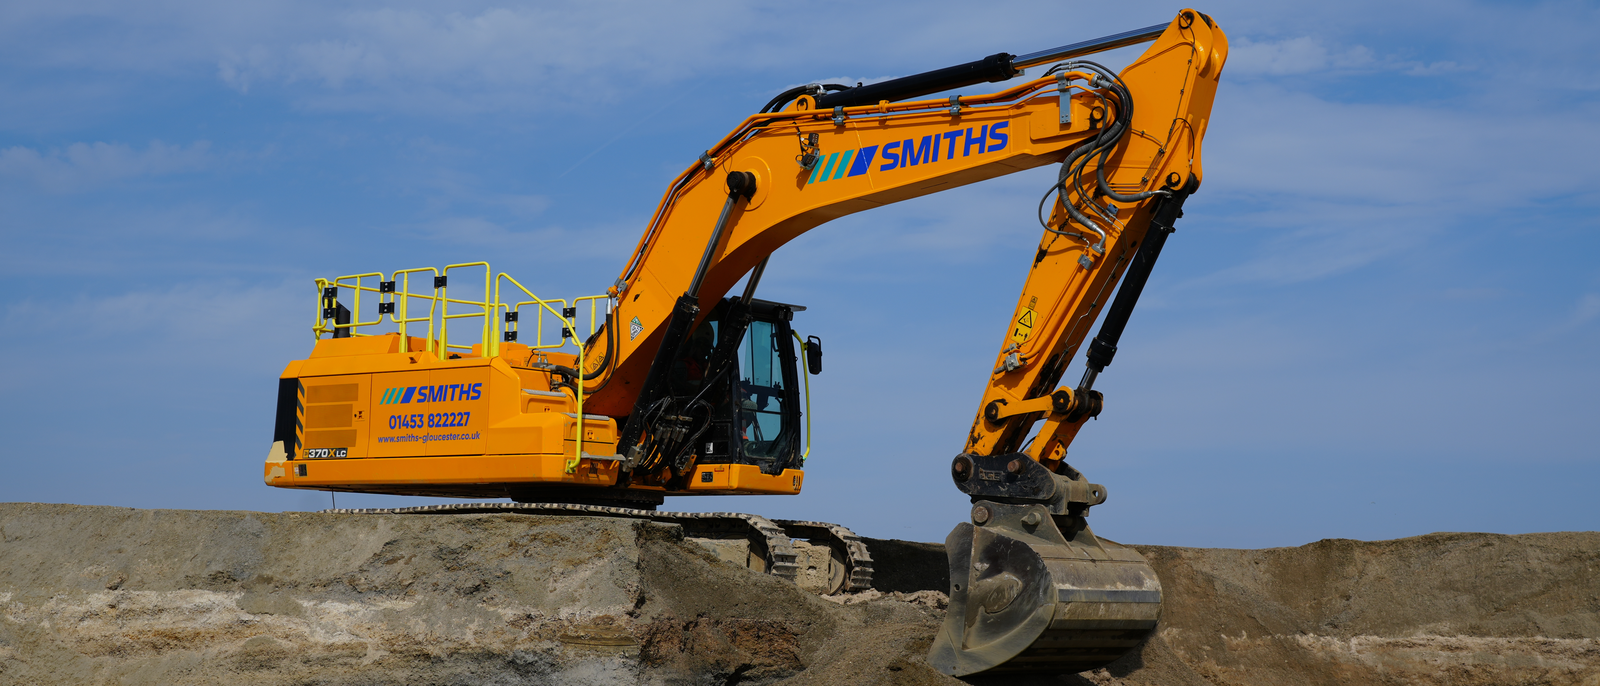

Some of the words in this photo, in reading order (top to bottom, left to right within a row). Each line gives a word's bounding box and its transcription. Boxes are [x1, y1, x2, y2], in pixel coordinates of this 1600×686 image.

[880, 120, 1010, 172] SMITHS
[416, 382, 483, 404] SMITHS
[389, 413, 425, 430] 01453
[428, 411, 471, 429] 822227
[377, 431, 480, 444] www.smiths-gloucester.co.uk
